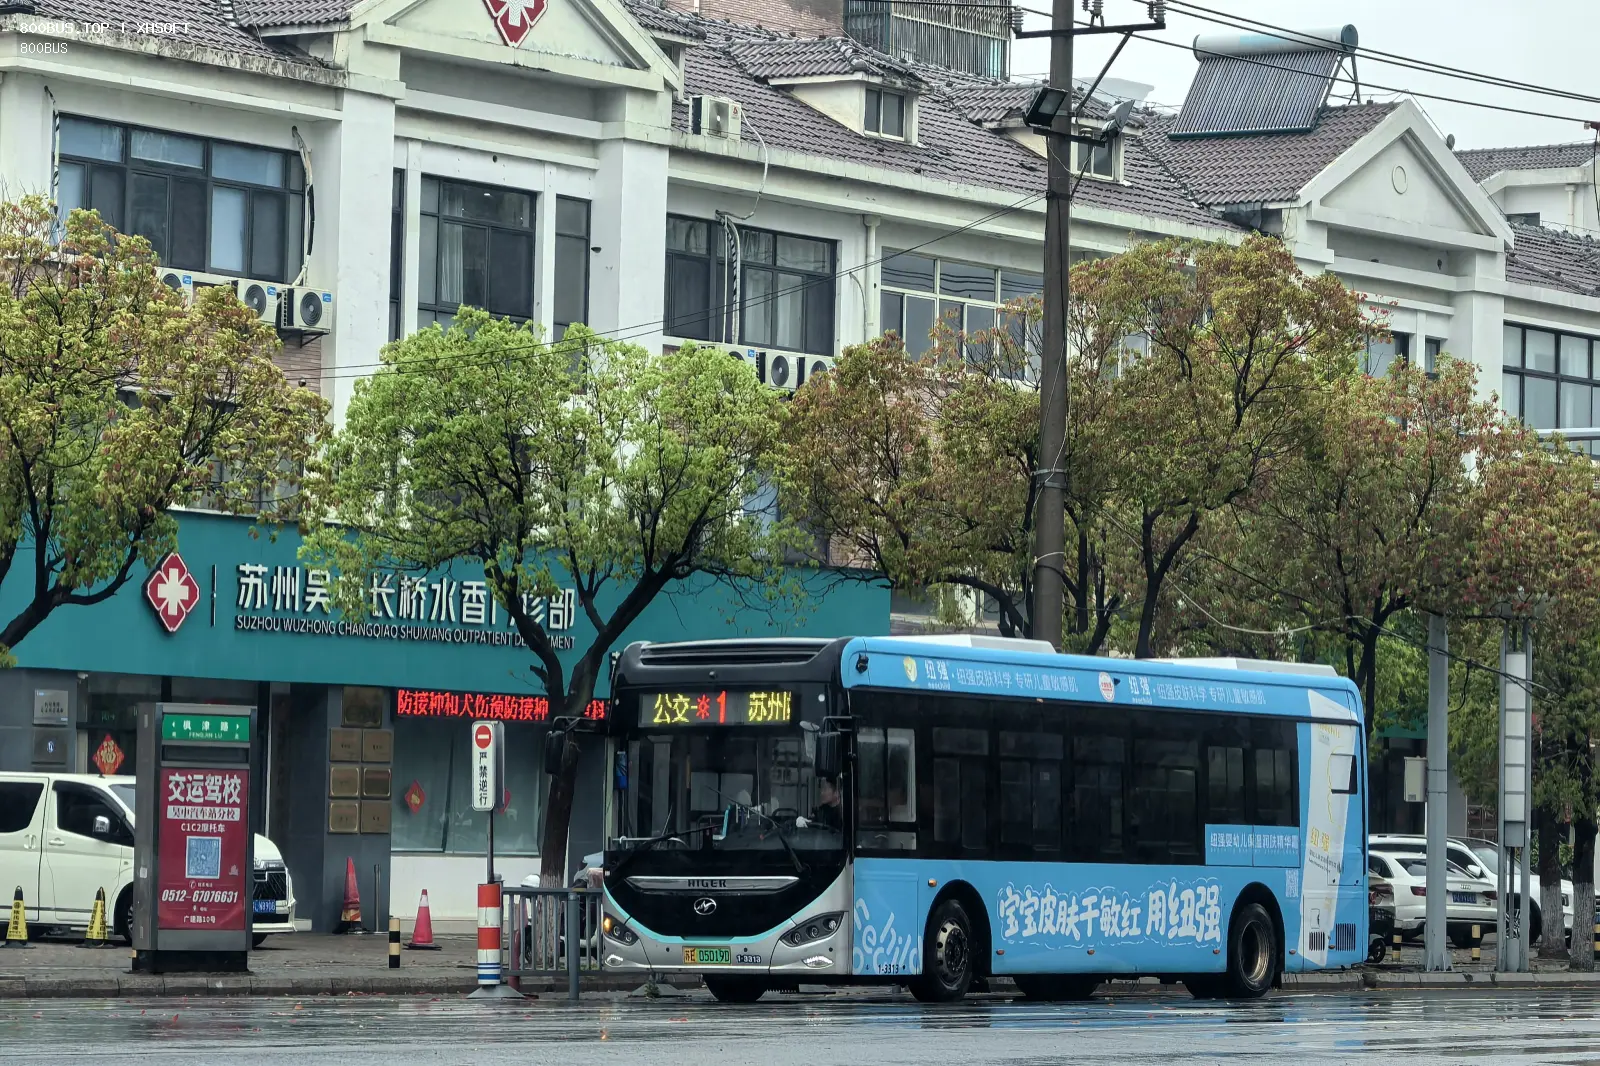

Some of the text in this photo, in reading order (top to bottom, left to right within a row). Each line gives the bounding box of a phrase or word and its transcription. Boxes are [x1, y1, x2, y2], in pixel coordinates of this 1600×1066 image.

[238, 562, 575, 630] 苏州吴长桥水香诊部
[236, 615, 576, 650] SUZHOU WUZHONG CHANGQIAO SHUIXIANG OUTPATIENT DEMENT
[925, 659, 949, 680] 纽强
[716, 690, 727, 723] 1
[748, 691, 791, 721] 苏州
[167, 772, 241, 804] 交运驾校
[479, 751, 488, 806] 严禁逆行
[161, 889, 238, 903] 0512-67076631
[1000, 882, 1221, 942] 宝宝皮肤干敏红 用纽强
